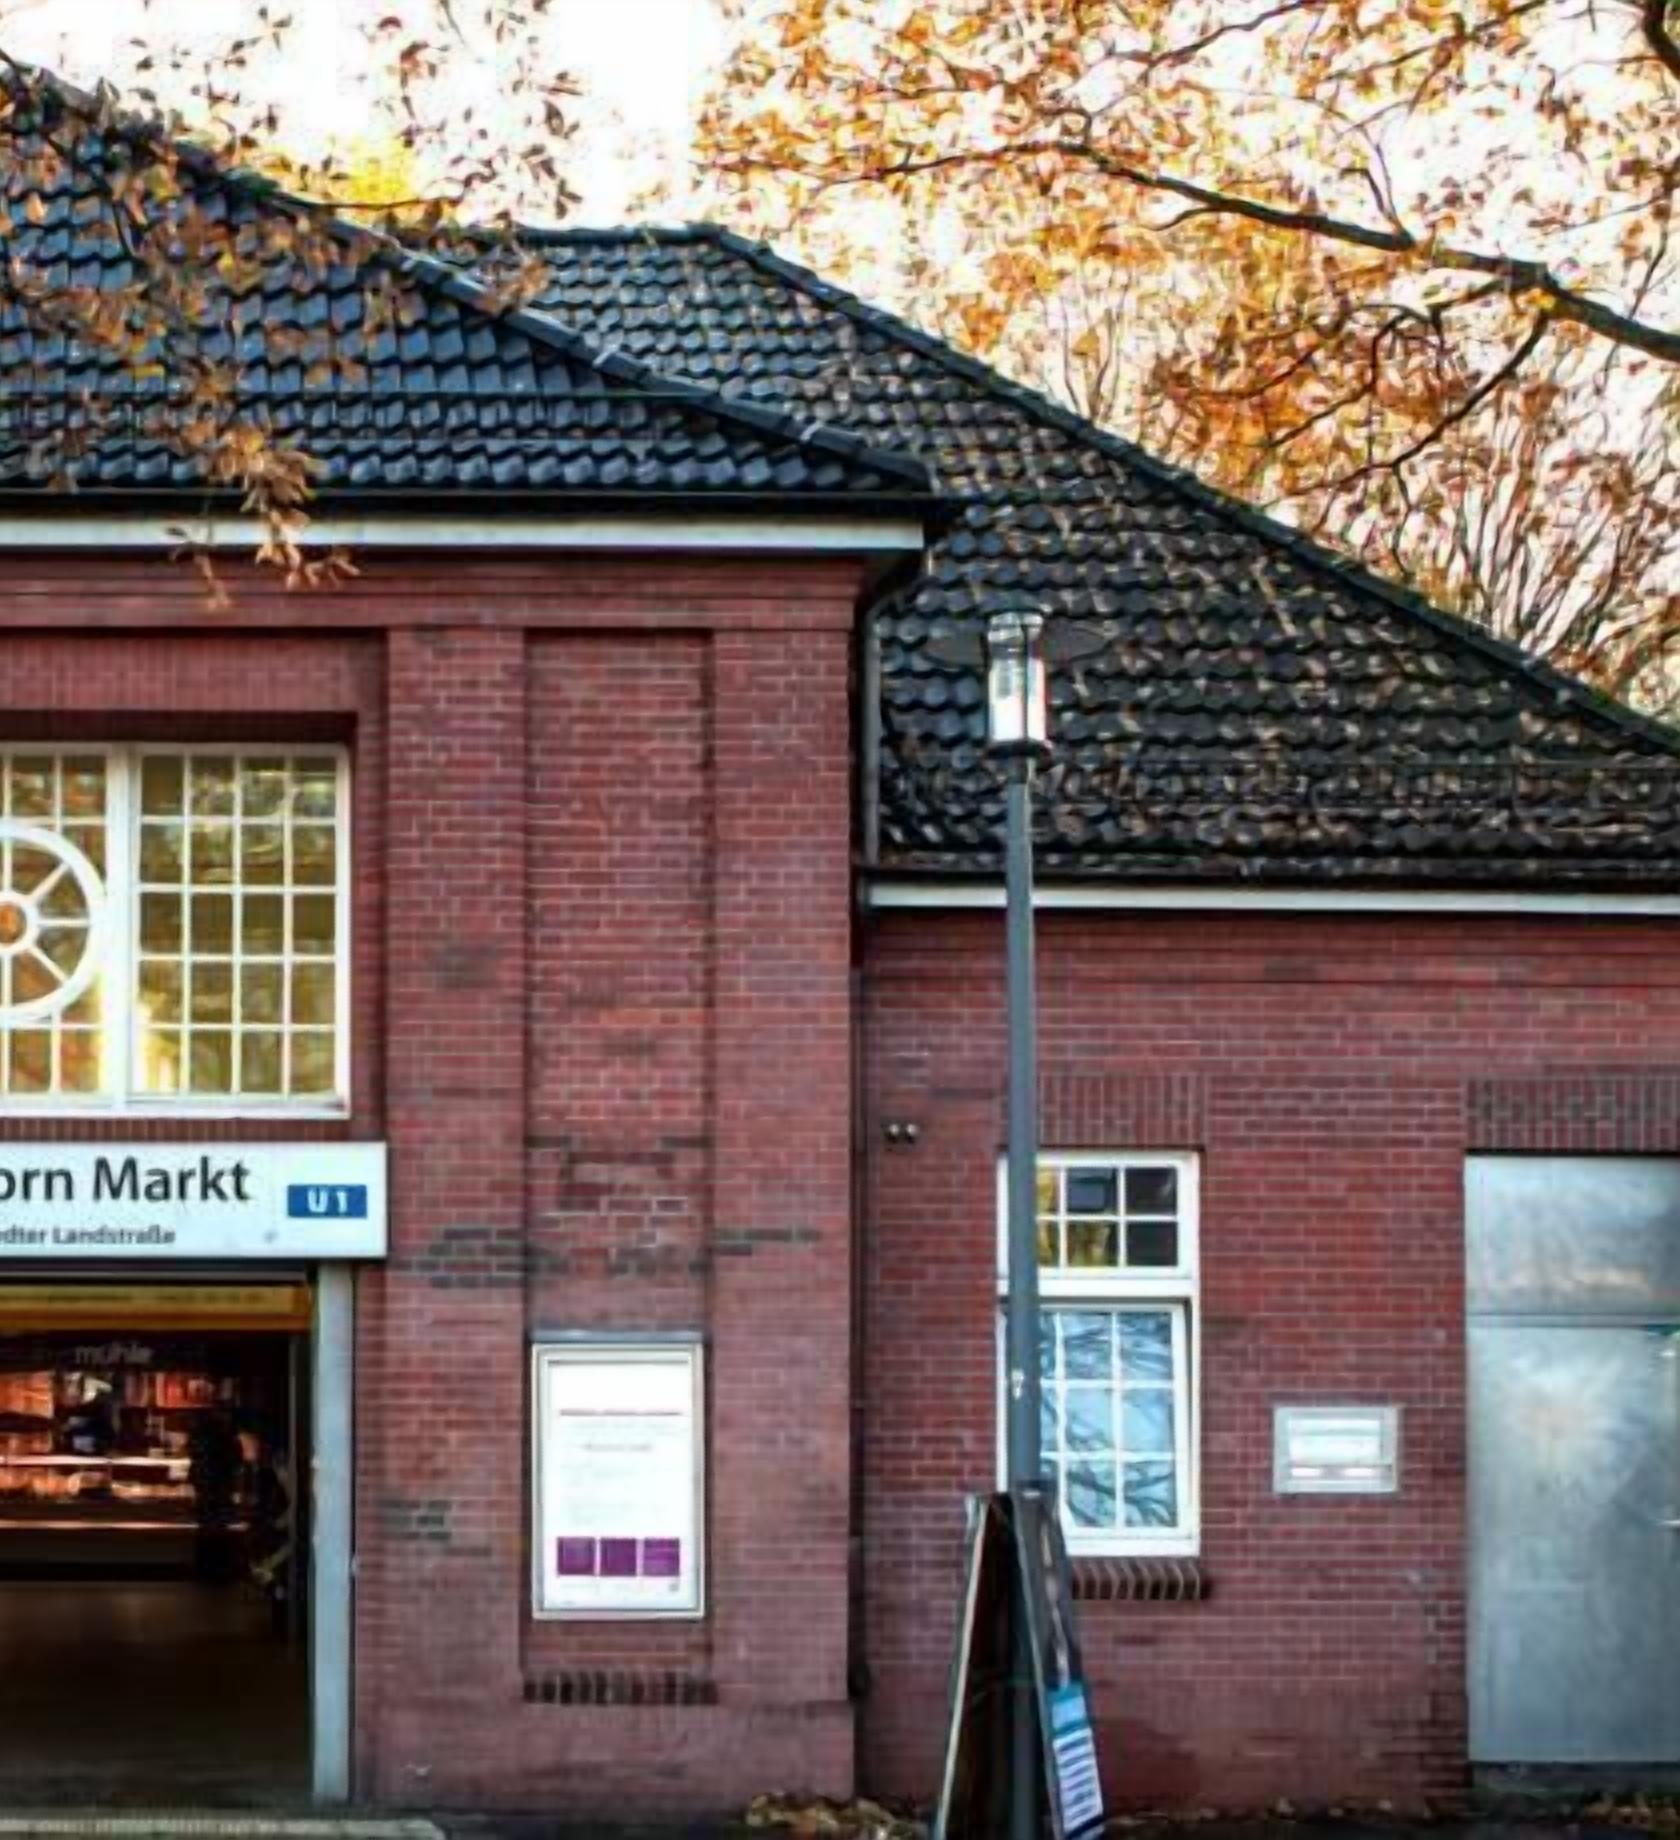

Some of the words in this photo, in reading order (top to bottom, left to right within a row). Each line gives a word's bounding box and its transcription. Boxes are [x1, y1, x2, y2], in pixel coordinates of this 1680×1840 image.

[92, 1156, 252, 1203] Markt
[307, 1188, 348, 1213] U1
[52, 1224, 177, 1245] Landstraße
